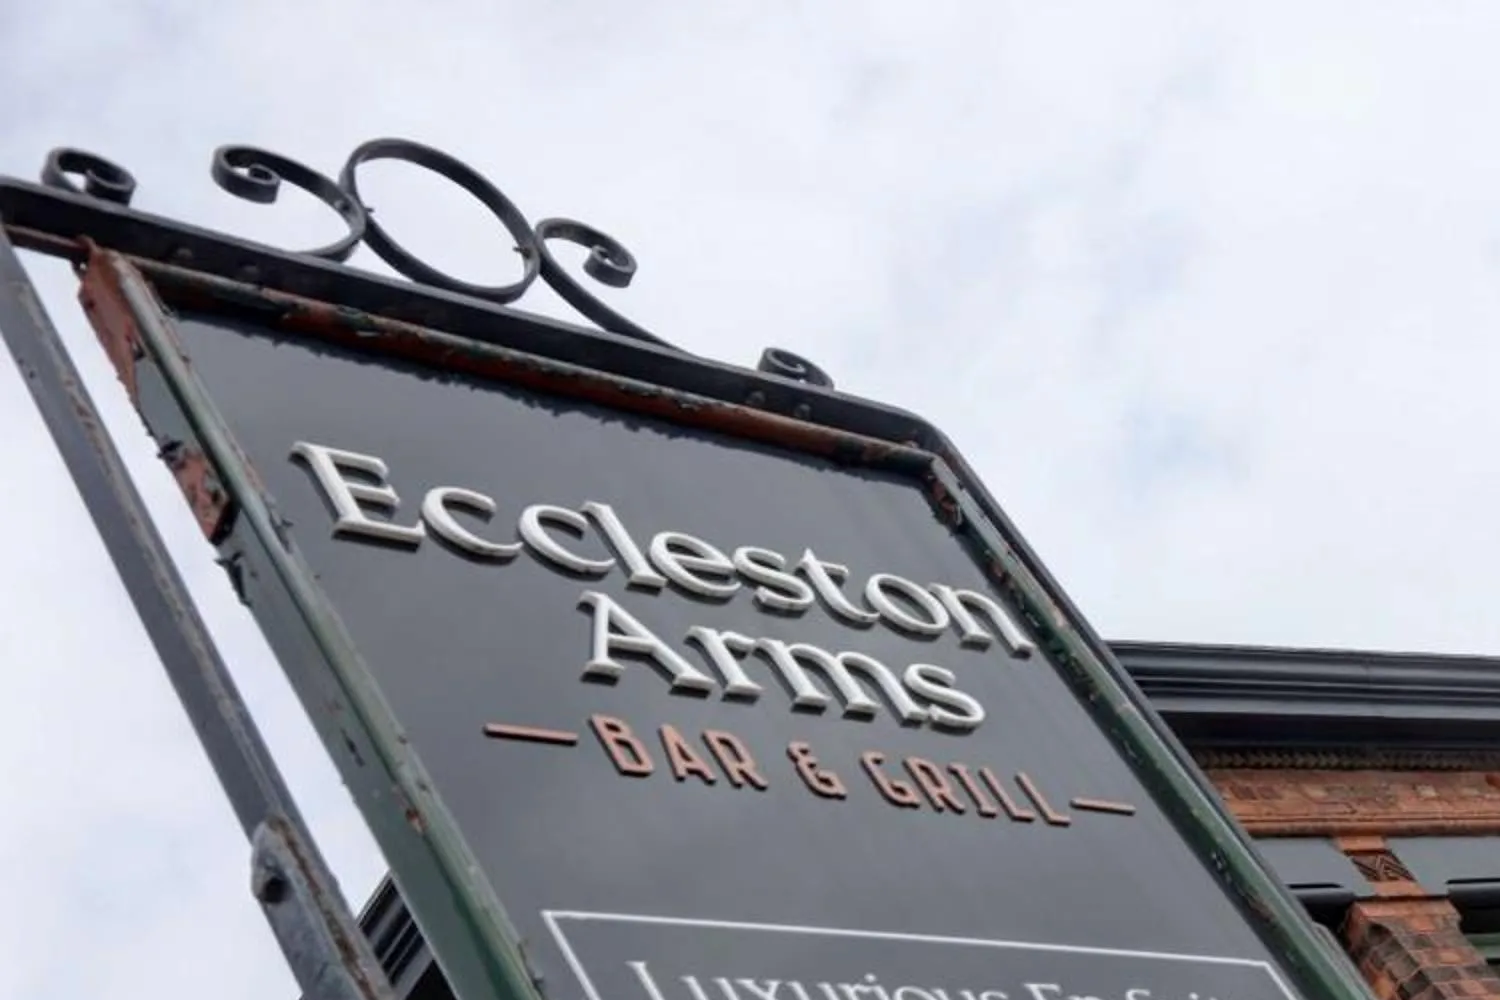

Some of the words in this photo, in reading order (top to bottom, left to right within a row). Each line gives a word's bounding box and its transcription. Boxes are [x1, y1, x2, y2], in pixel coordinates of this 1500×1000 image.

[291, 441, 1035, 656] Eccleston
[579, 590, 985, 730] Arms
[588, 713, 768, 790] BAR
[786, 741, 847, 799] &
[860, 750, 1071, 827] GRILL
